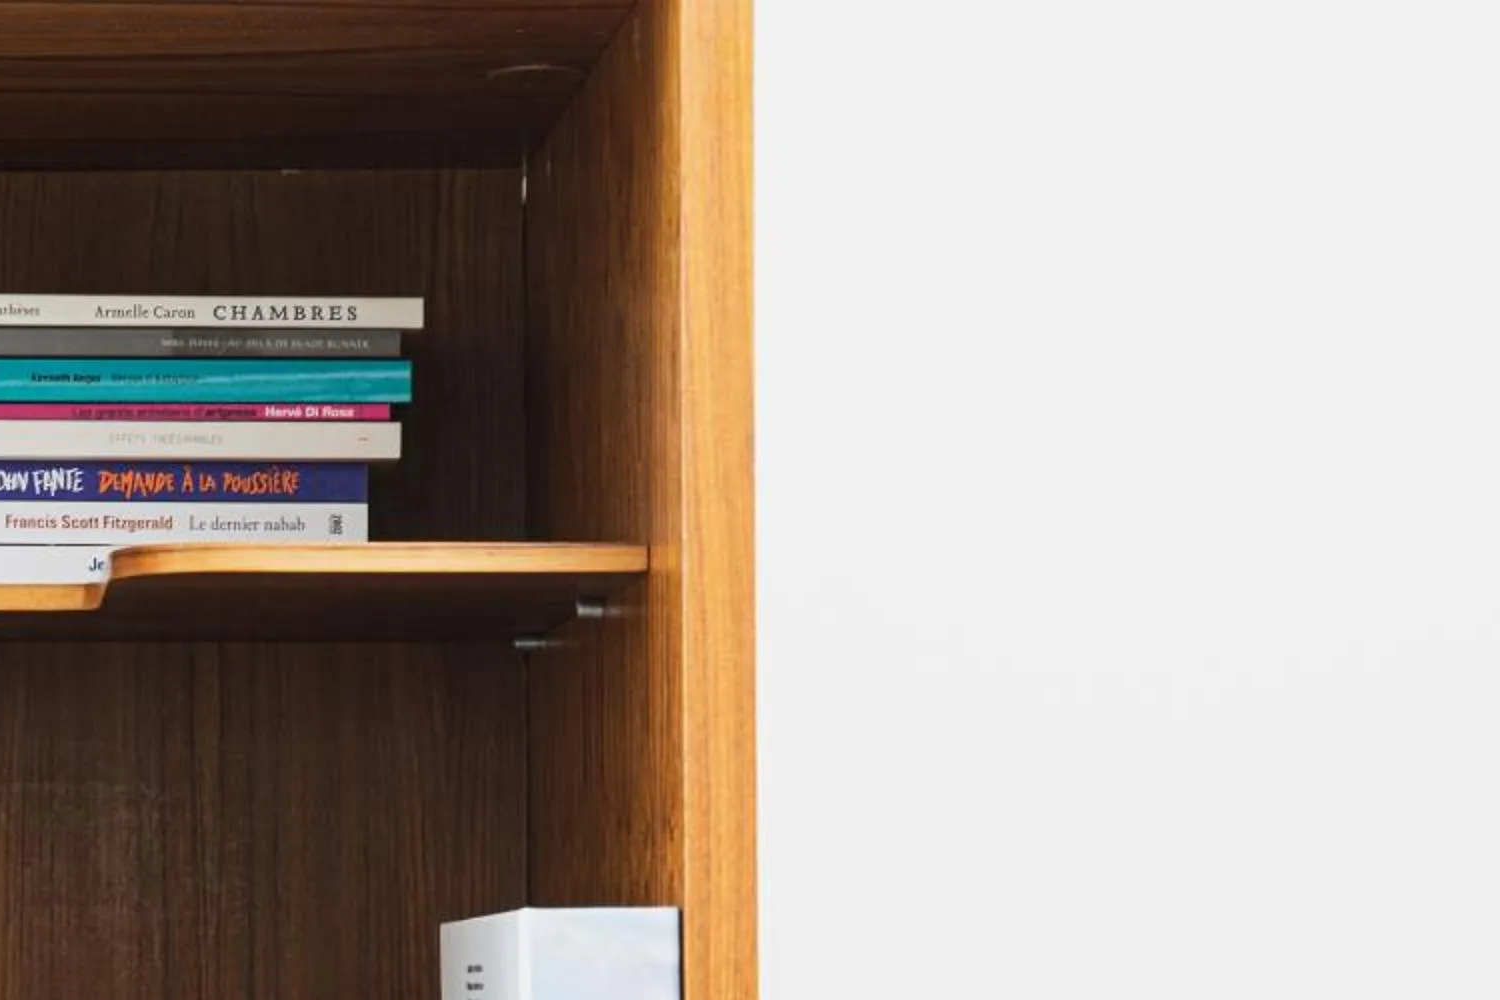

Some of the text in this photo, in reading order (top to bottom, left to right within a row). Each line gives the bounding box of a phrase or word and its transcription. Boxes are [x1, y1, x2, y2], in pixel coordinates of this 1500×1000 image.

[94, 304, 196, 318] Armelle Caron
[212, 304, 359, 321] CHAMBRES
[264, 405, 301, 418] Hervé
[305, 406, 320, 418] Di
[32, 467, 84, 496] FANTE
[99, 470, 175, 498] DEMANDE
[181, 465, 195, 493] À
[199, 473, 217, 493] LA
[222, 466, 301, 495] POUSSIÈRE
[5, 514, 174, 532] Francis Scott Fitzgerald
[189, 515, 306, 532] Le dernier nabab
